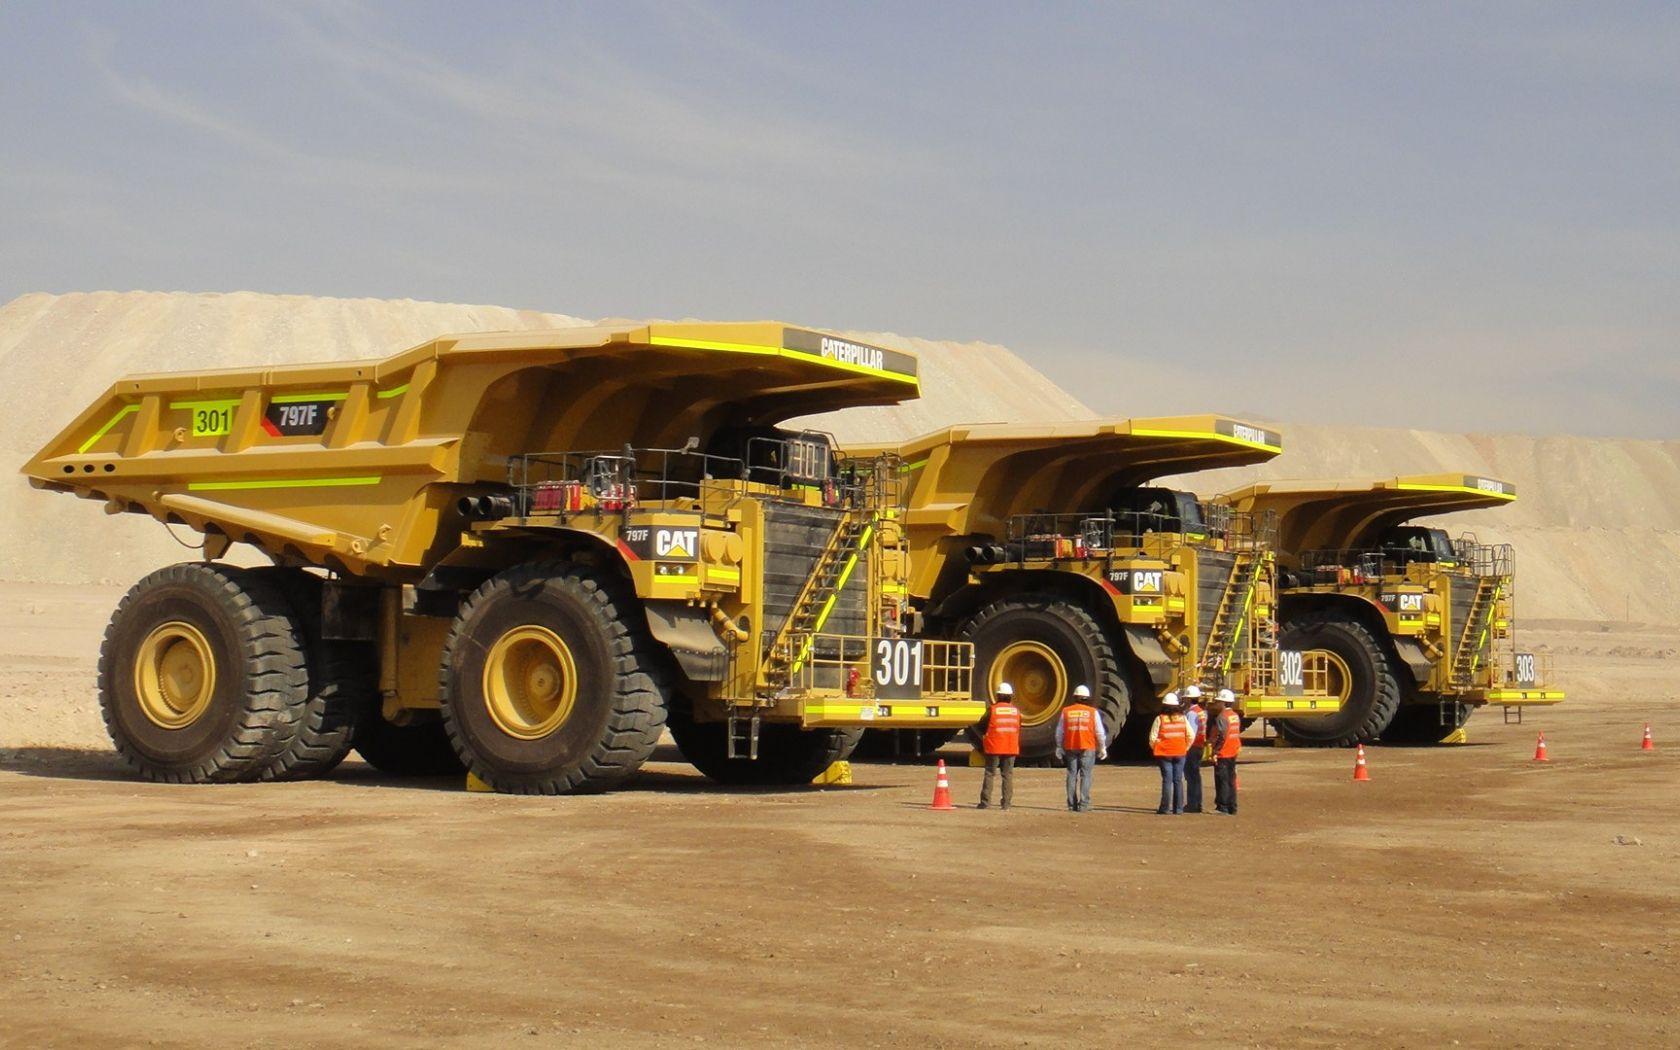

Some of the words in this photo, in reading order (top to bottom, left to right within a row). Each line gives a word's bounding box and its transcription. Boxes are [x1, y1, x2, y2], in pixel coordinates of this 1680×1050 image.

[821, 337, 884, 371] CATERPILLAR
[196, 409, 229, 433] 301
[280, 404, 318, 426] 797F
[626, 529, 648, 542] 797F
[656, 529, 698, 557] CAT
[1109, 571, 1129, 581] 797F
[1134, 571, 1162, 591] CAT
[1400, 594, 1423, 610] CAT
[876, 640, 922, 686] 301
[1280, 651, 1303, 686] 302
[1516, 655, 1535, 682] 303
